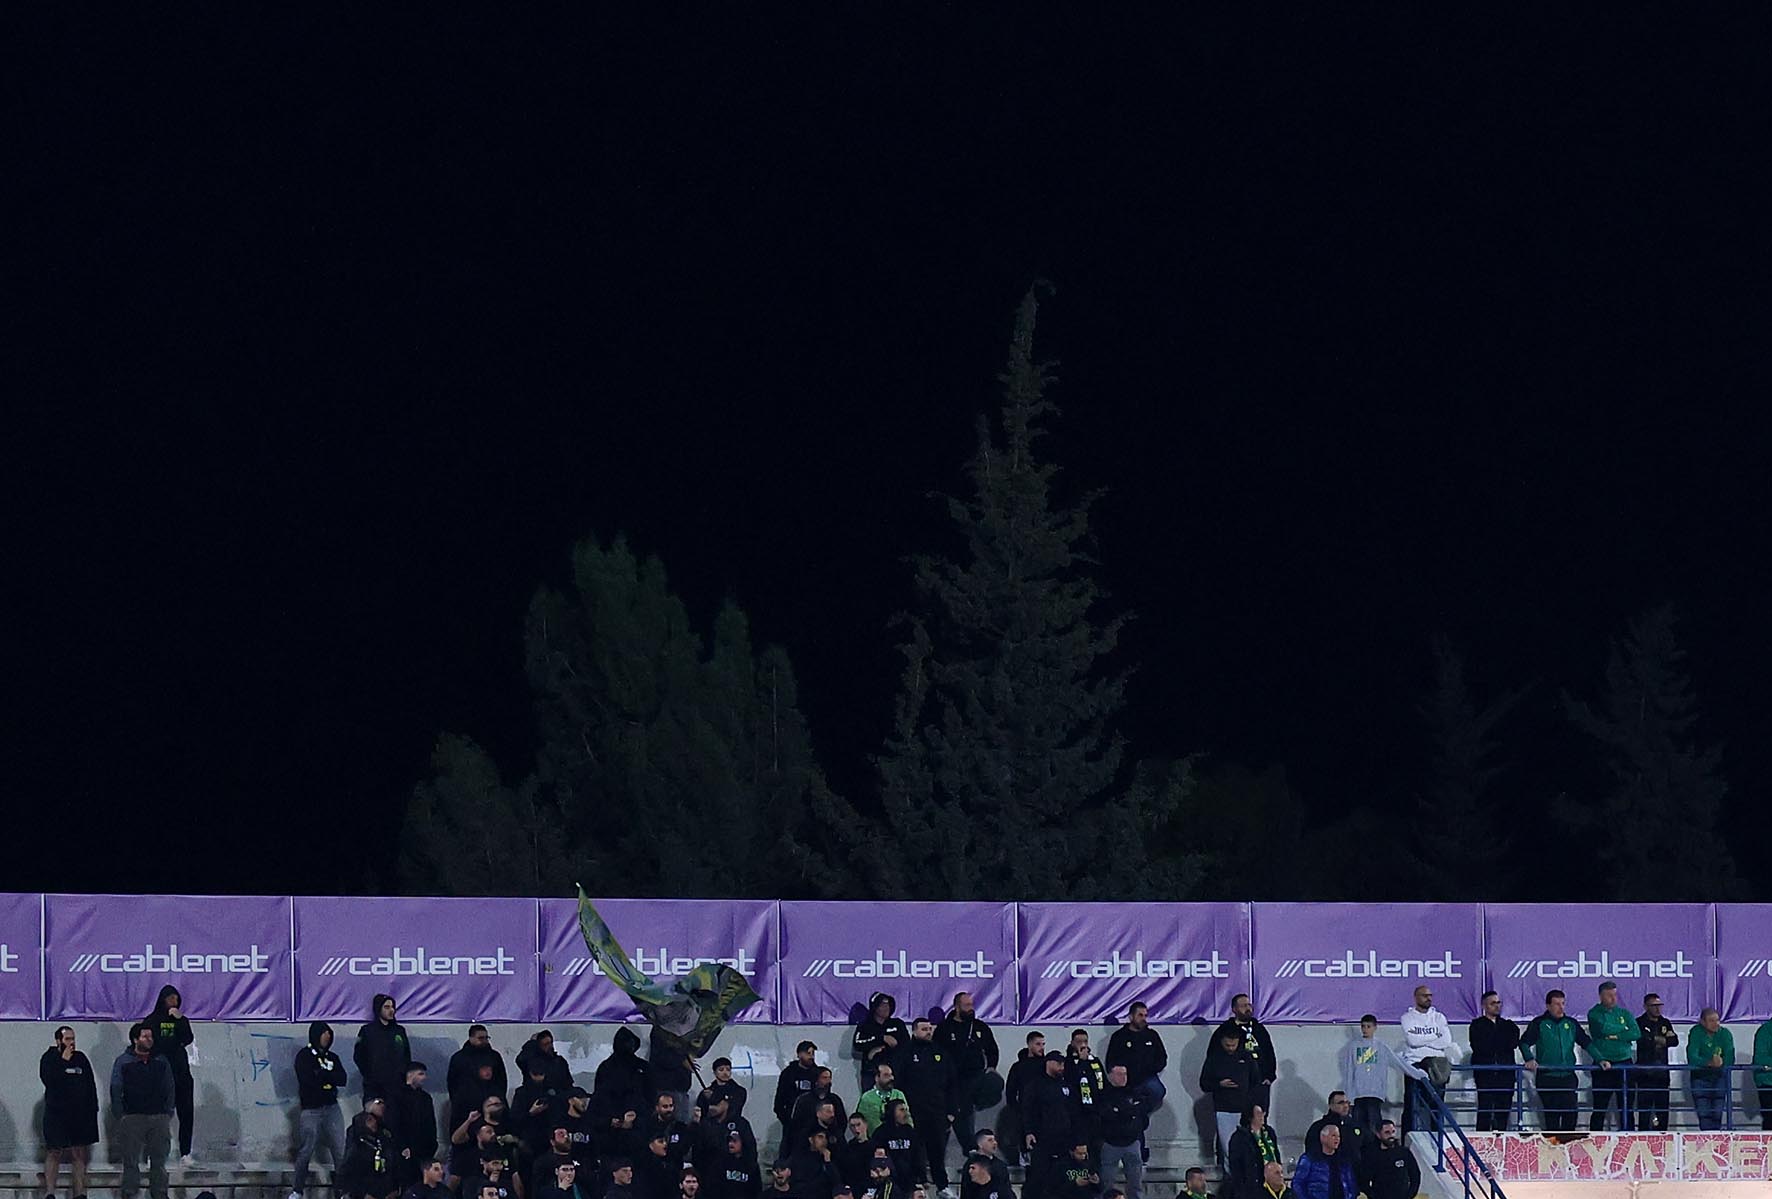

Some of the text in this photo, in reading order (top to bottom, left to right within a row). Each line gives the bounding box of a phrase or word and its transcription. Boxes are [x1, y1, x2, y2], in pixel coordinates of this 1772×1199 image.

[100, 945, 269, 973] cablenet
[348, 947, 515, 975] cablenet
[833, 950, 994, 978] cablenet
[1070, 950, 1229, 978] cablenet
[1304, 950, 1462, 978] cablenet
[1536, 950, 1693, 978] cablenet
